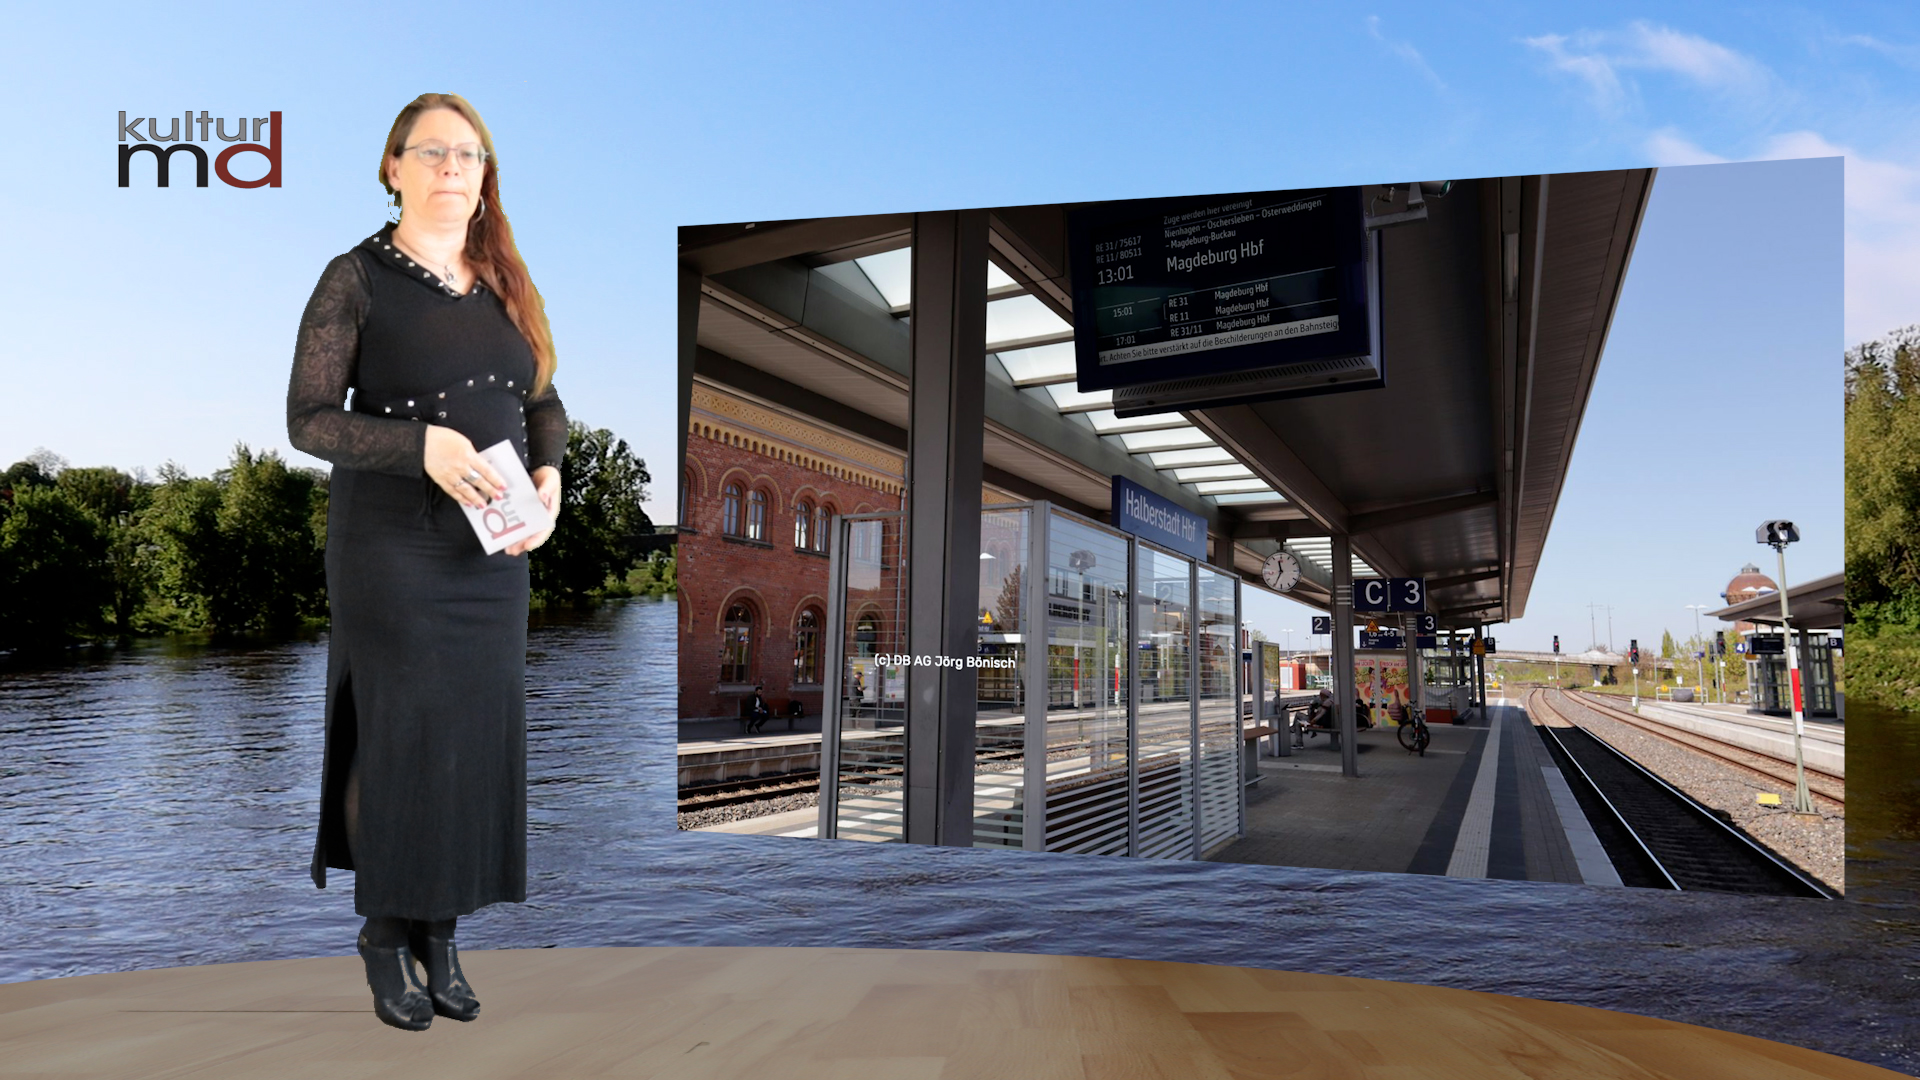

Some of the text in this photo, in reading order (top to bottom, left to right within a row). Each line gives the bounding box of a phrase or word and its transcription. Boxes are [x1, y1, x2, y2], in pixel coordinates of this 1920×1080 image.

[1164, 224, 1200, 238] Nienhagen
[1207, 213, 1254, 230] Oschersleben
[1261, 199, 1322, 218] Osterweddingen
[1180, 210, 1206, 220] werden
[1206, 206, 1221, 215] hier
[1095, 243, 1104, 252] RE
[1170, 230, 1236, 250] Magdeburg-Buckau
[1096, 255, 1104, 264] RE
[1166, 238, 1264, 272] Magdeburg Hbf
[1098, 264, 1134, 285] 13:01
[1215, 282, 1268, 300] Magdeburg Hbf
[1168, 297, 1188, 308] RE 31
[1216, 298, 1270, 315] Magdeburg Hbf
[1112, 306, 1133, 318] 15:01
[1170, 312, 1190, 322] RE 11
[1216, 313, 1270, 330] Magdeburg Hbf
[1170, 324, 1202, 337] RE 31/11
[1110, 351, 1131, 361] Achten
[1132, 350, 1142, 358] Sie
[1143, 348, 1158, 356] bitte
[1160, 342, 1188, 354] verstärkt
[1190, 340, 1202, 349] auf
[1202, 338, 1212, 348] die
[1214, 328, 1272, 346] Beschilderungen
[1274, 328, 1283, 336] an
[1284, 326, 1298, 334] den
[1116, 334, 1136, 346] 17:01
[1126, 488, 1196, 542] Halberstadt Hbf
[1365, 581, 1383, 604] C
[1404, 580, 1420, 604] 3
[1314, 618, 1323, 631] 2
[1424, 616, 1434, 630] 3
[1736, 644, 1744, 652] 4
